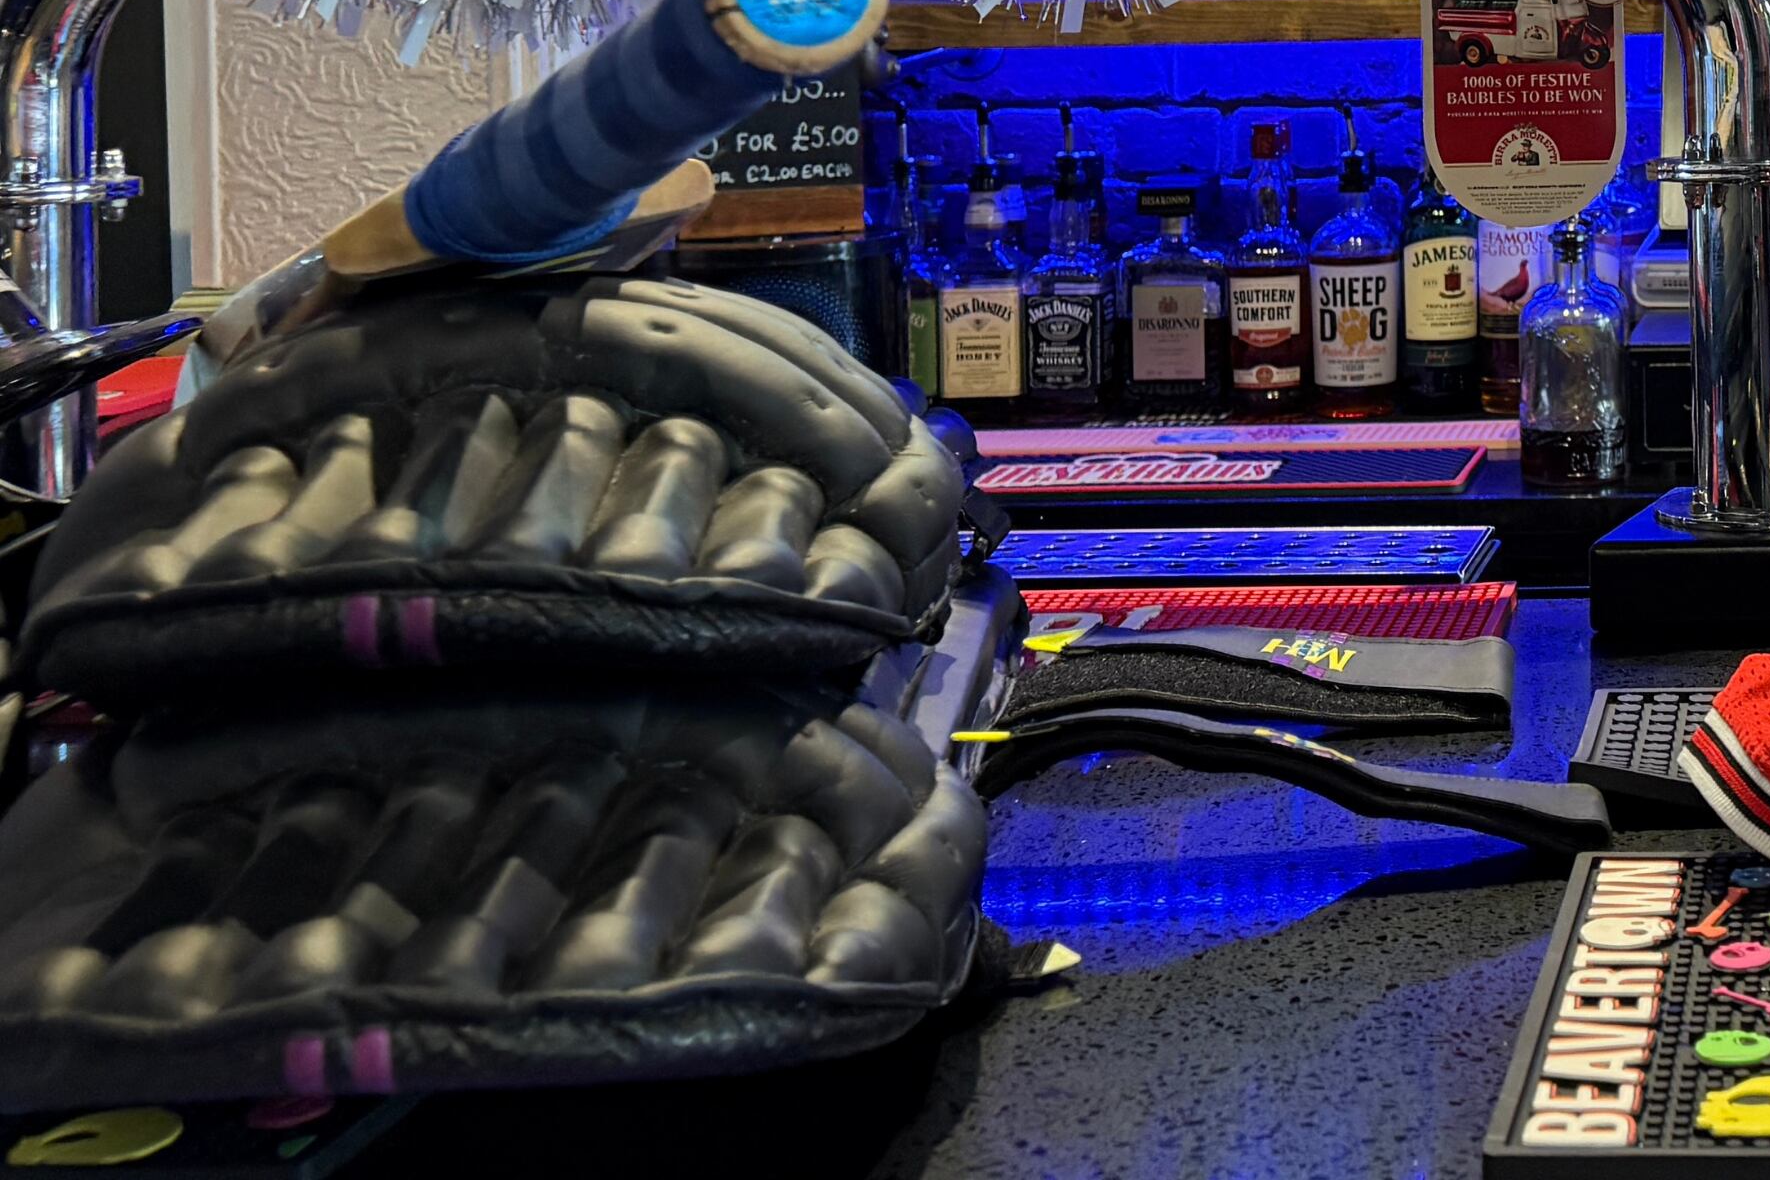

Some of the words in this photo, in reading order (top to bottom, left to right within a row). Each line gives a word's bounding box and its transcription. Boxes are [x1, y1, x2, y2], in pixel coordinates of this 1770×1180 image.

[1463, 75, 1502, 88] 1000s
[1506, 75, 1525, 87] OF
[1531, 73, 1591, 87] FESTIVE
[1447, 91, 1516, 105] BAUBLES
[1521, 91, 1540, 103] TO
[1545, 90, 1564, 103] BE
[736, 133, 777, 153] FOR
[792, 122, 859, 152] £5.00
[1495, 133, 1519, 166] BIRRA
[1520, 131, 1558, 165] MORETTI
[746, 165, 798, 184] £2.00
[1142, 195, 1190, 205] DISARONNO
[1413, 246, 1477, 268] JAMESO
[1233, 288, 1295, 305] SOUTHERN
[1320, 277, 1386, 307] SHEEP
[945, 303, 970, 323] JACK
[1028, 305, 1052, 324] JACK
[1237, 306, 1292, 321] COMFORT
[1138, 318, 1200, 331] DISARONNO
[974, 460, 1283, 488] DESPERADOS
